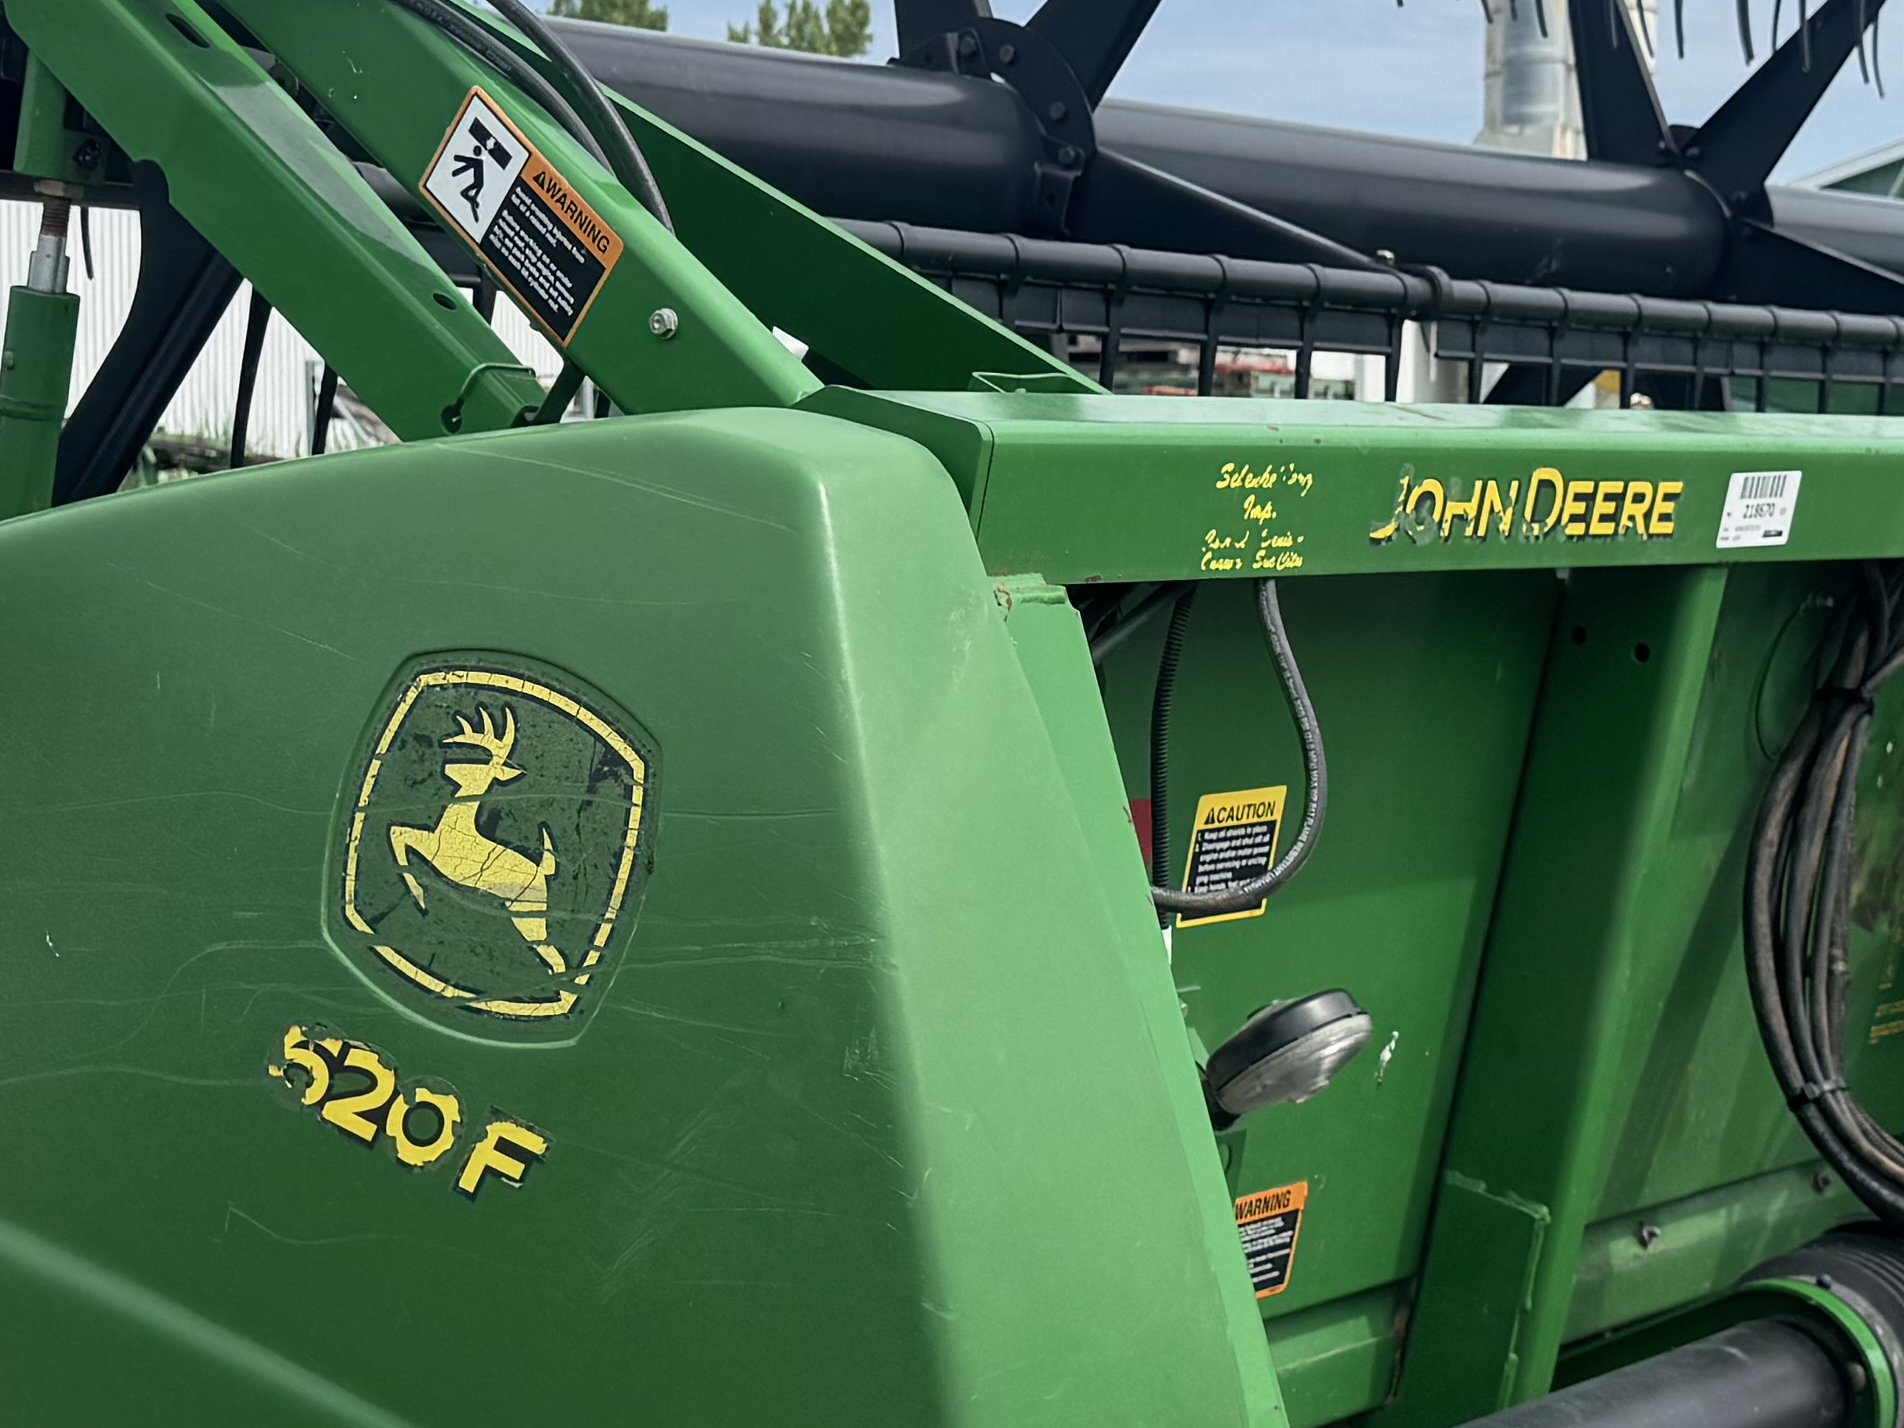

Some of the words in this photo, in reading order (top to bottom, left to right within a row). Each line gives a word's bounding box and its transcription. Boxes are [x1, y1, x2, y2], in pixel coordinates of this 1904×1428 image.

[546, 177, 610, 254] WARNING
[1368, 472, 1520, 540] JOHN
[1523, 466, 1684, 539] DEERE
[1216, 799, 1276, 825] CAUTION
[1235, 1189, 1291, 1220] WARNING
